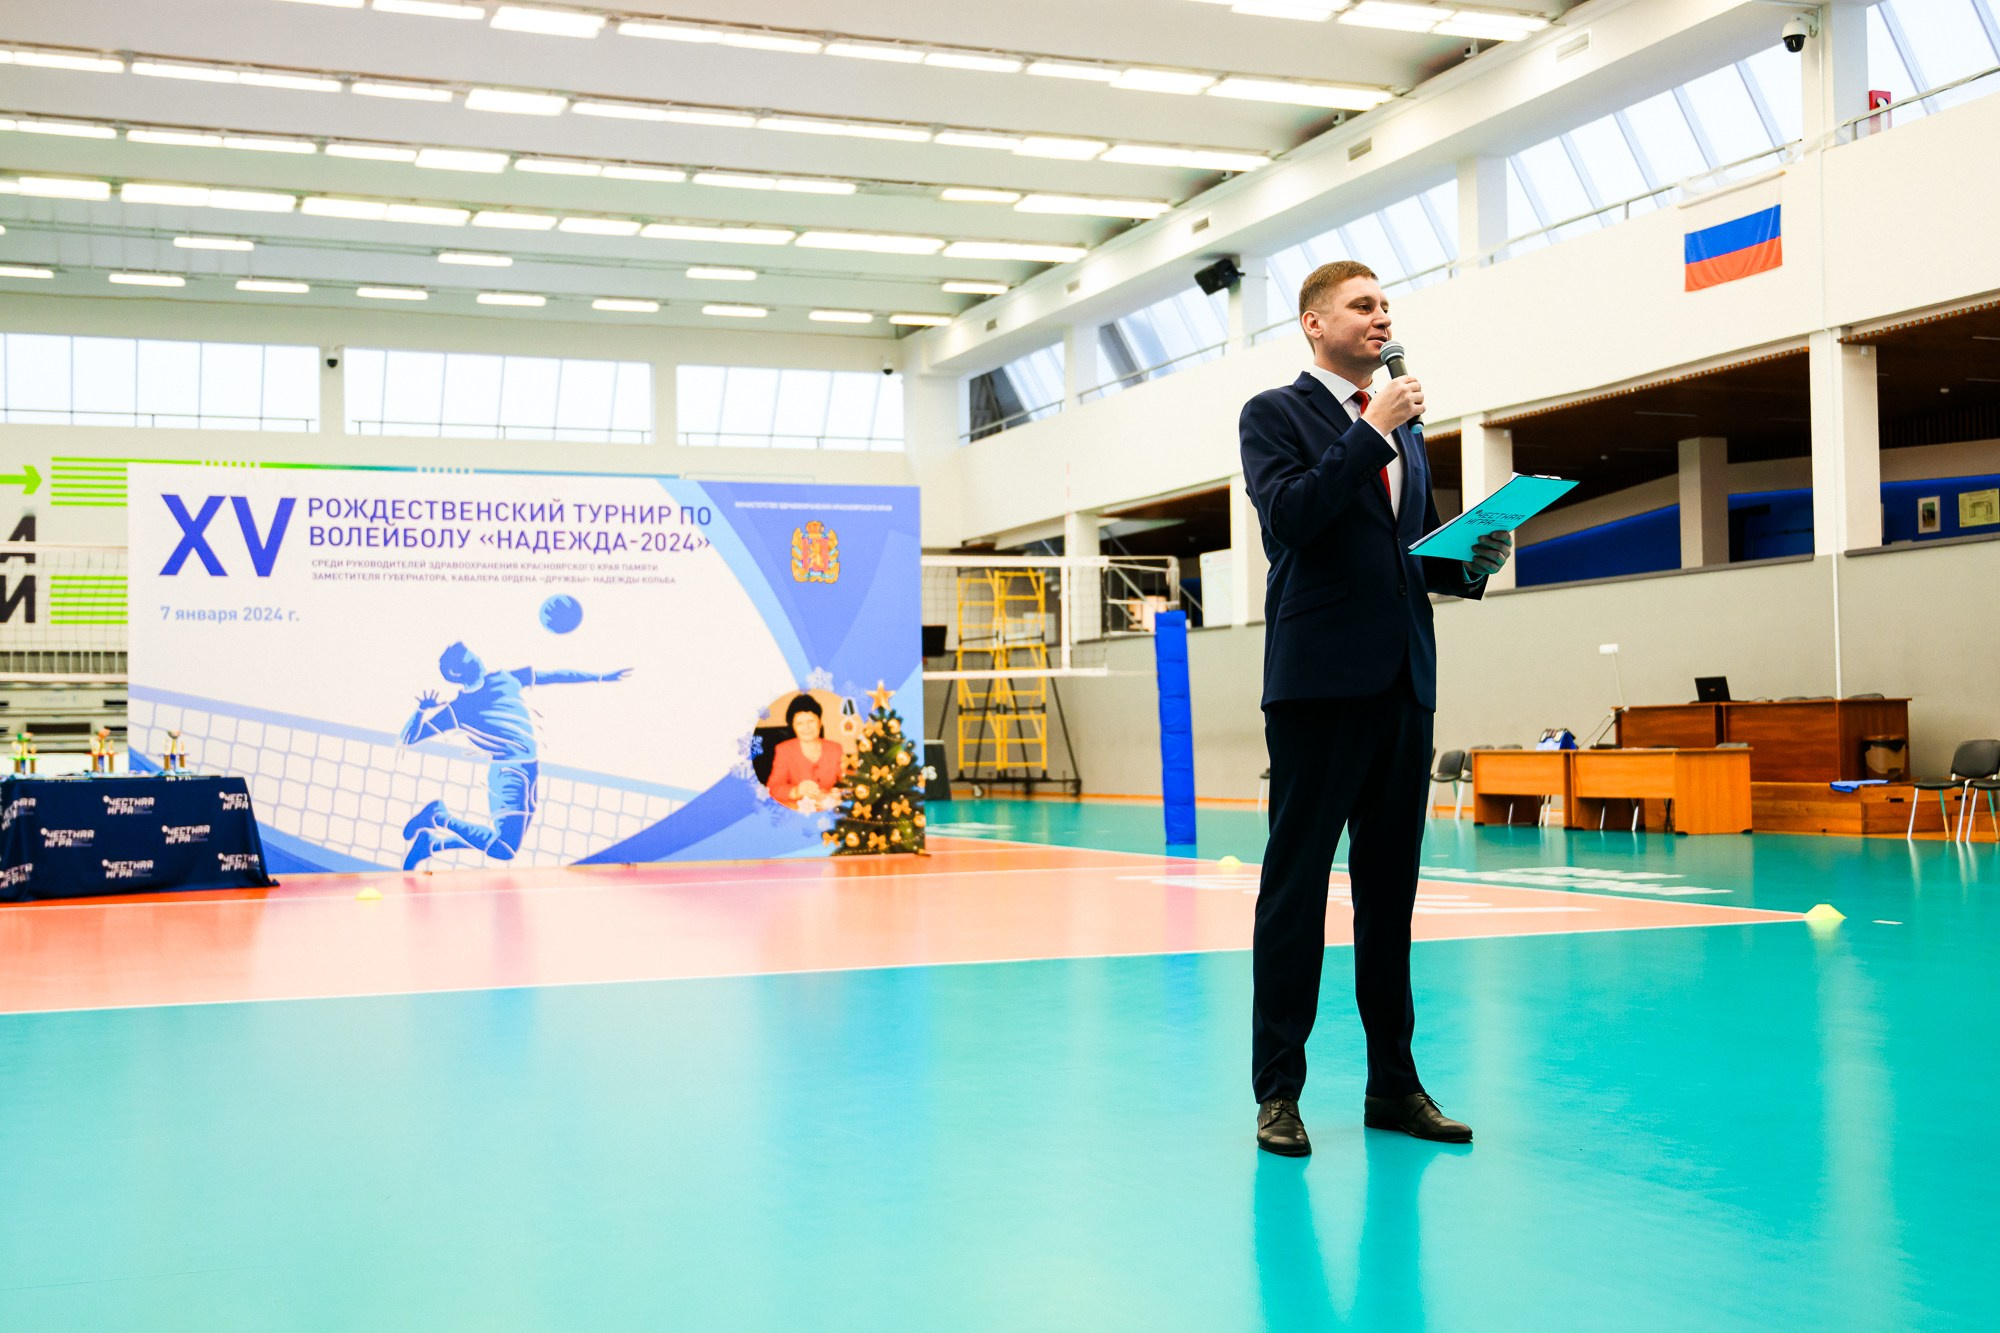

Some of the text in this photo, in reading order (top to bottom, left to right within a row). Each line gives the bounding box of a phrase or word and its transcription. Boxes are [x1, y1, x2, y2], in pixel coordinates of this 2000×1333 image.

[308, 497, 565, 524] РОЖДЕСТВЕНСКИЙ
[573, 503, 672, 524] ТУРНИР
[680, 506, 712, 526] ПО
[159, 494, 297, 577] XV
[309, 522, 711, 555] ВОЛЕЙБОЛУ «НАДЕЖДА-2024»
[311, 559, 659, 571] СРЕДИ РУКОВОДИТЕЛЕЙ ЗДРАВООХРАНЕНИЯ КРАСНОЯРСКОГО КРАЯ ПАМЯТИ
[312, 572, 381, 580] ЗАМЕСТИТЕЛЯ
[451, 574, 500, 582] КАВАЛЕРА
[502, 575, 538, 583] ОРДЕНА
[593, 576, 640, 584] НАДЕЖДЫ
[160, 605, 300, 624] 7 января 2024 г.
